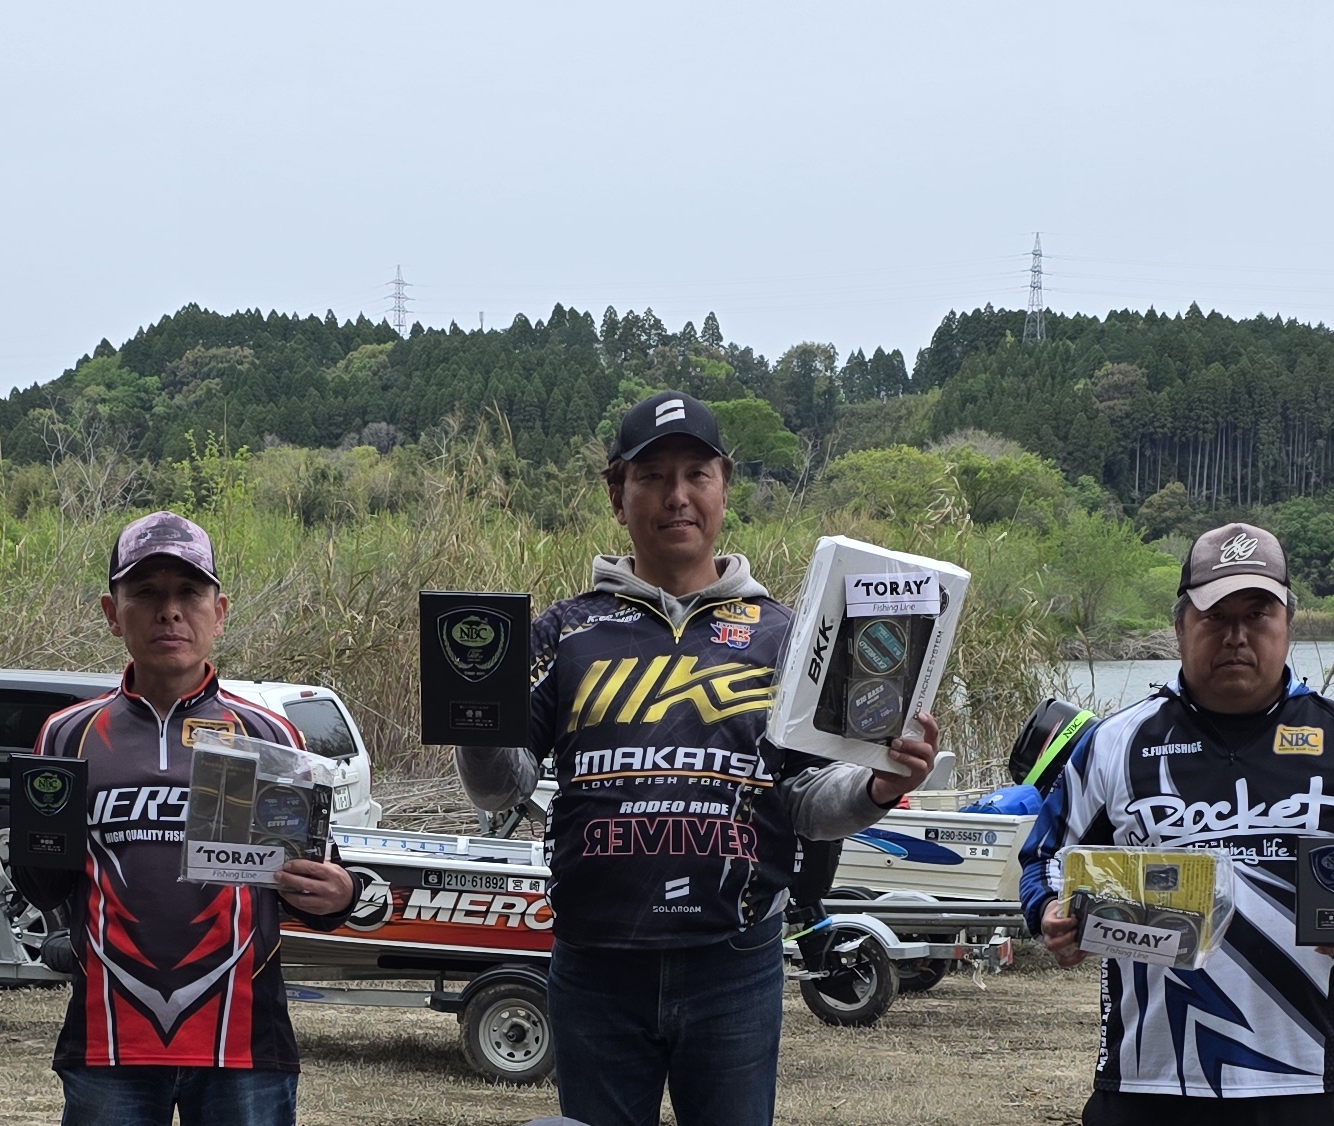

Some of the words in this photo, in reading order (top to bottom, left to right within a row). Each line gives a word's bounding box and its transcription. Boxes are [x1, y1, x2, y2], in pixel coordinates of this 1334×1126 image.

[873, 603, 898, 613] Fishing
[808, 614, 835, 686] BKK
[1278, 731, 1319, 748] NBC
[1142, 741, 1203, 758] S.FUKUSHIGE
[582, 778, 625, 790] LOVE
[635, 776, 678, 785] FISH
[688, 777, 721, 787] FOR
[619, 800, 686, 814] RODEO
[688, 800, 730, 815] RIDE
[105, 830, 125, 843] HIGH
[126, 829, 164, 841] QUALITY
[1263, 838, 1290, 857] life
[240, 870, 257, 880] Line
[428, 873, 438, 883] 6
